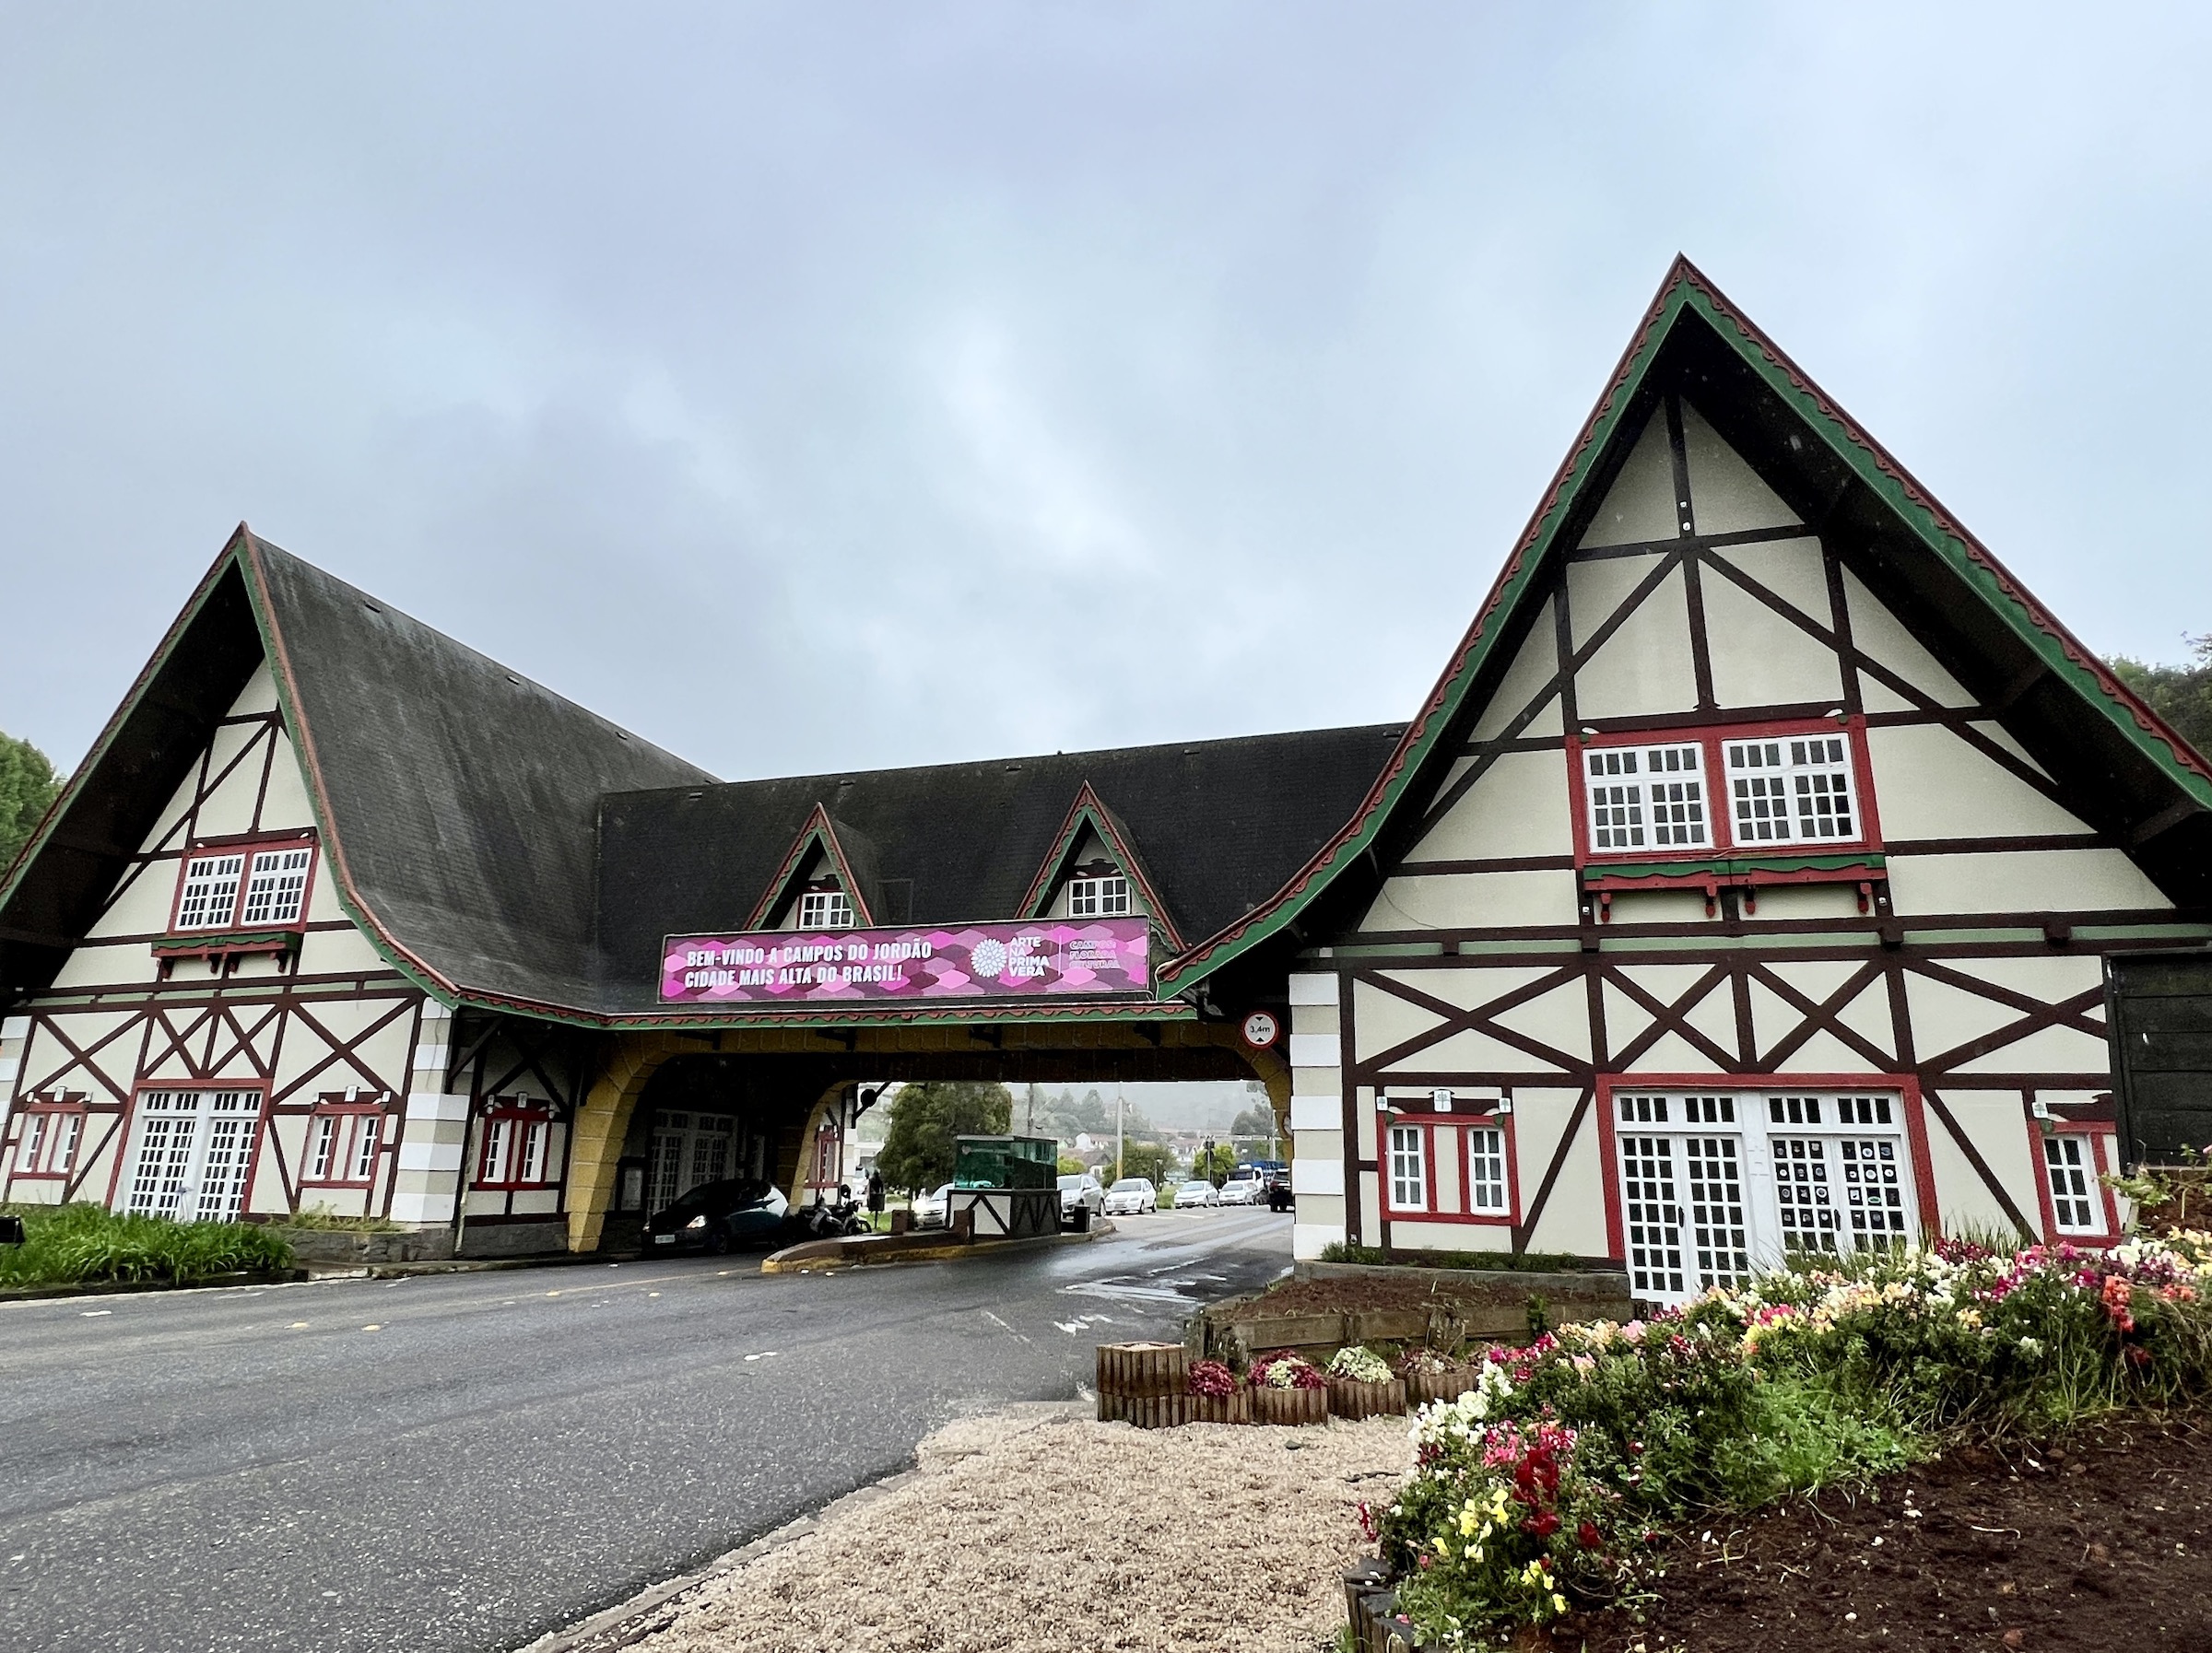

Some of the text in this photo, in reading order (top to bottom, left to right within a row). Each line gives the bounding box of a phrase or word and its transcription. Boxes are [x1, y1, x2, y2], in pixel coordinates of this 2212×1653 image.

[1010, 936, 1041, 947] ARTE
[687, 937, 932, 967] BEM-VINDO A CAMPOS DO JORDÃO
[1010, 946, 1027, 956] NA
[1008, 955, 1050, 967] PRIMA
[685, 964, 902, 988] CIDADE MAIS ALTA DO BRASIL!
[1008, 966, 1046, 977] VERA
